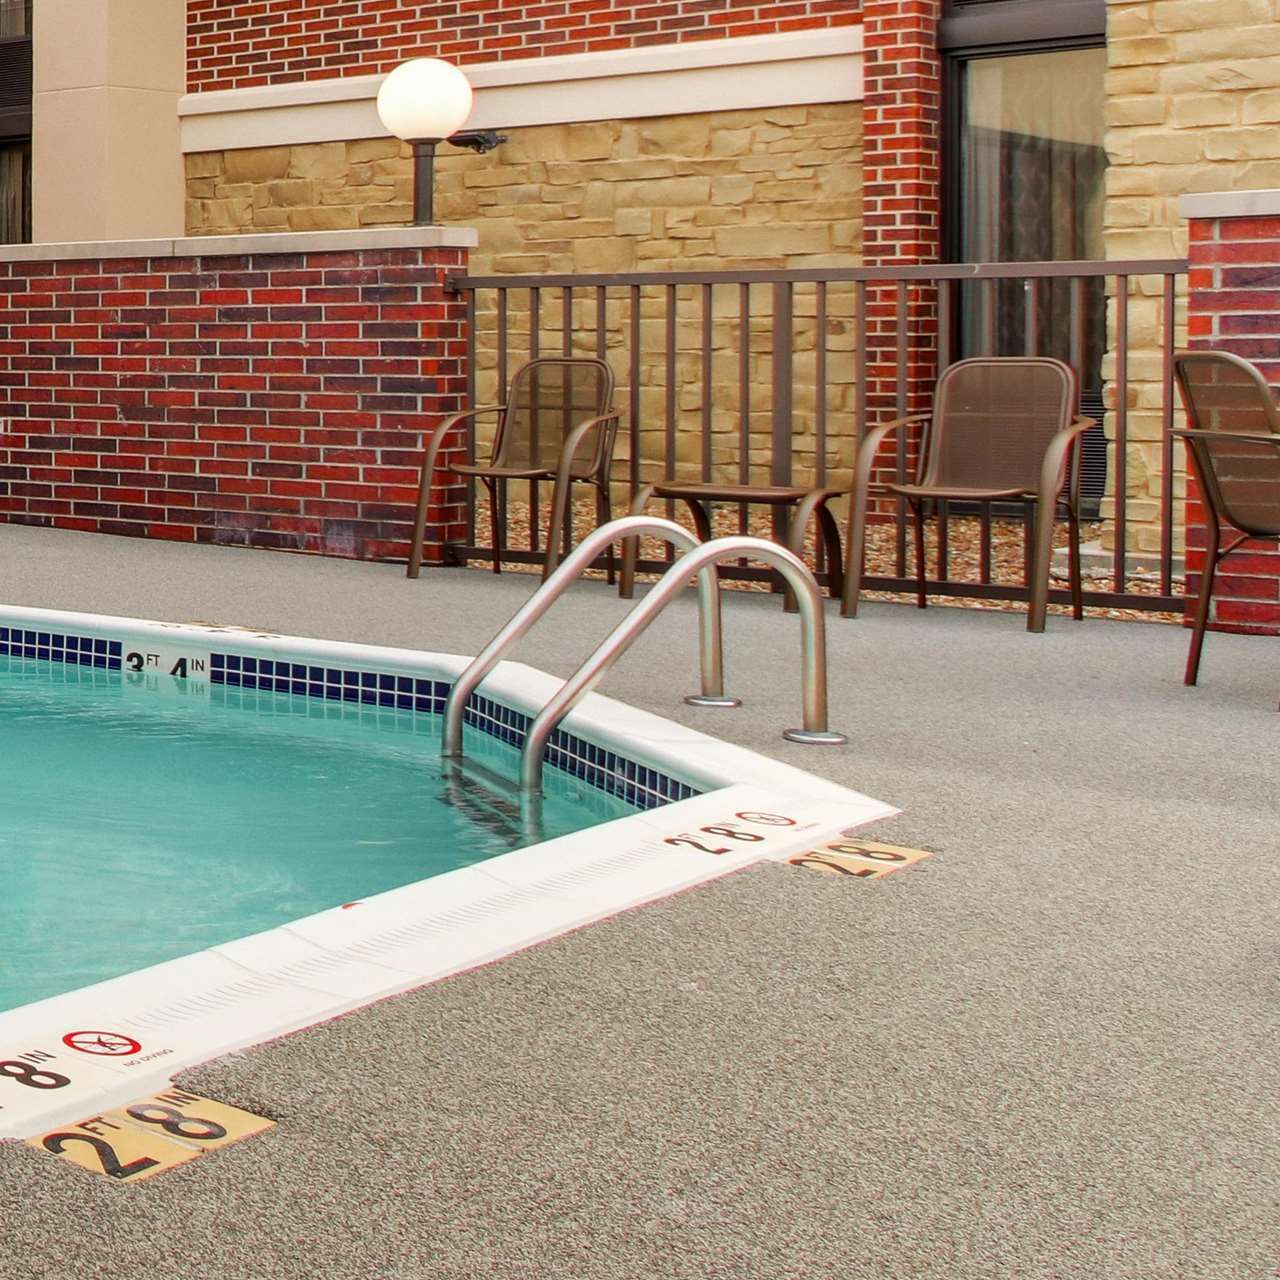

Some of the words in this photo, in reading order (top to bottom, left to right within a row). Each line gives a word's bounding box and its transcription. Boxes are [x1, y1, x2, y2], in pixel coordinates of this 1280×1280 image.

[126, 652, 144, 672] 3
[146, 654, 160, 666] FT
[169, 657, 187, 678] 4
[191, 659, 204, 671] IN
[663, 838, 733, 855] 2
[700, 827, 765, 842] 8
[826, 845, 906, 861] 8
[789, 859, 878, 877] 2
[17, 1050, 56, 1064] IN
[154, 1091, 200, 1107] IN
[75, 1116, 121, 1136] FT
[126, 1103, 227, 1140] 8
[42, 1132, 160, 1179] 2
